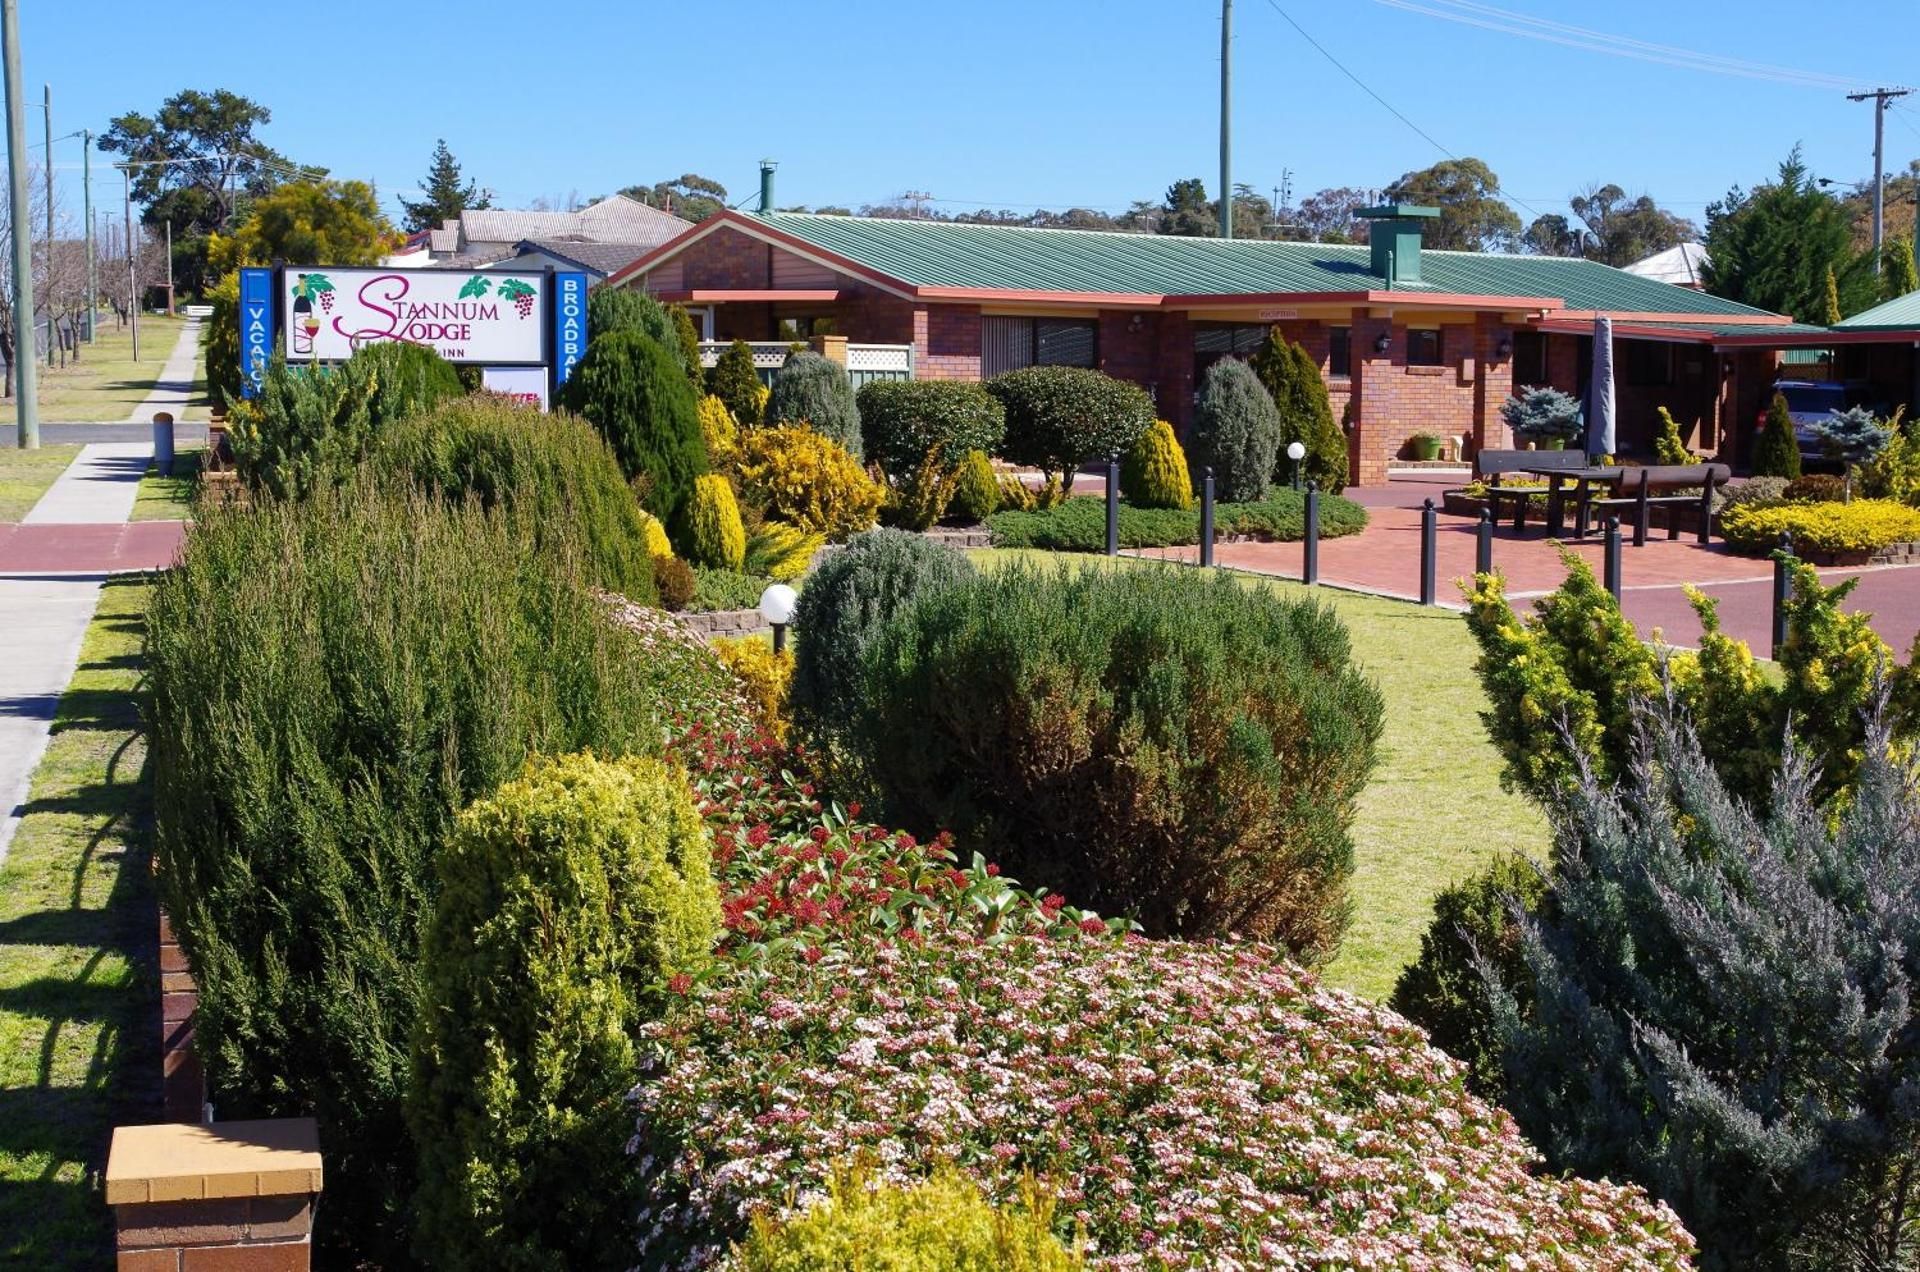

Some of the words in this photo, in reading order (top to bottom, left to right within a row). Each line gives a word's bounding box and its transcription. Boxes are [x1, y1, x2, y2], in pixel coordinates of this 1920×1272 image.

[333, 275, 500, 339] STANNUM
[564, 280, 579, 383] BROADBAN
[443, 349, 465, 358] INN
